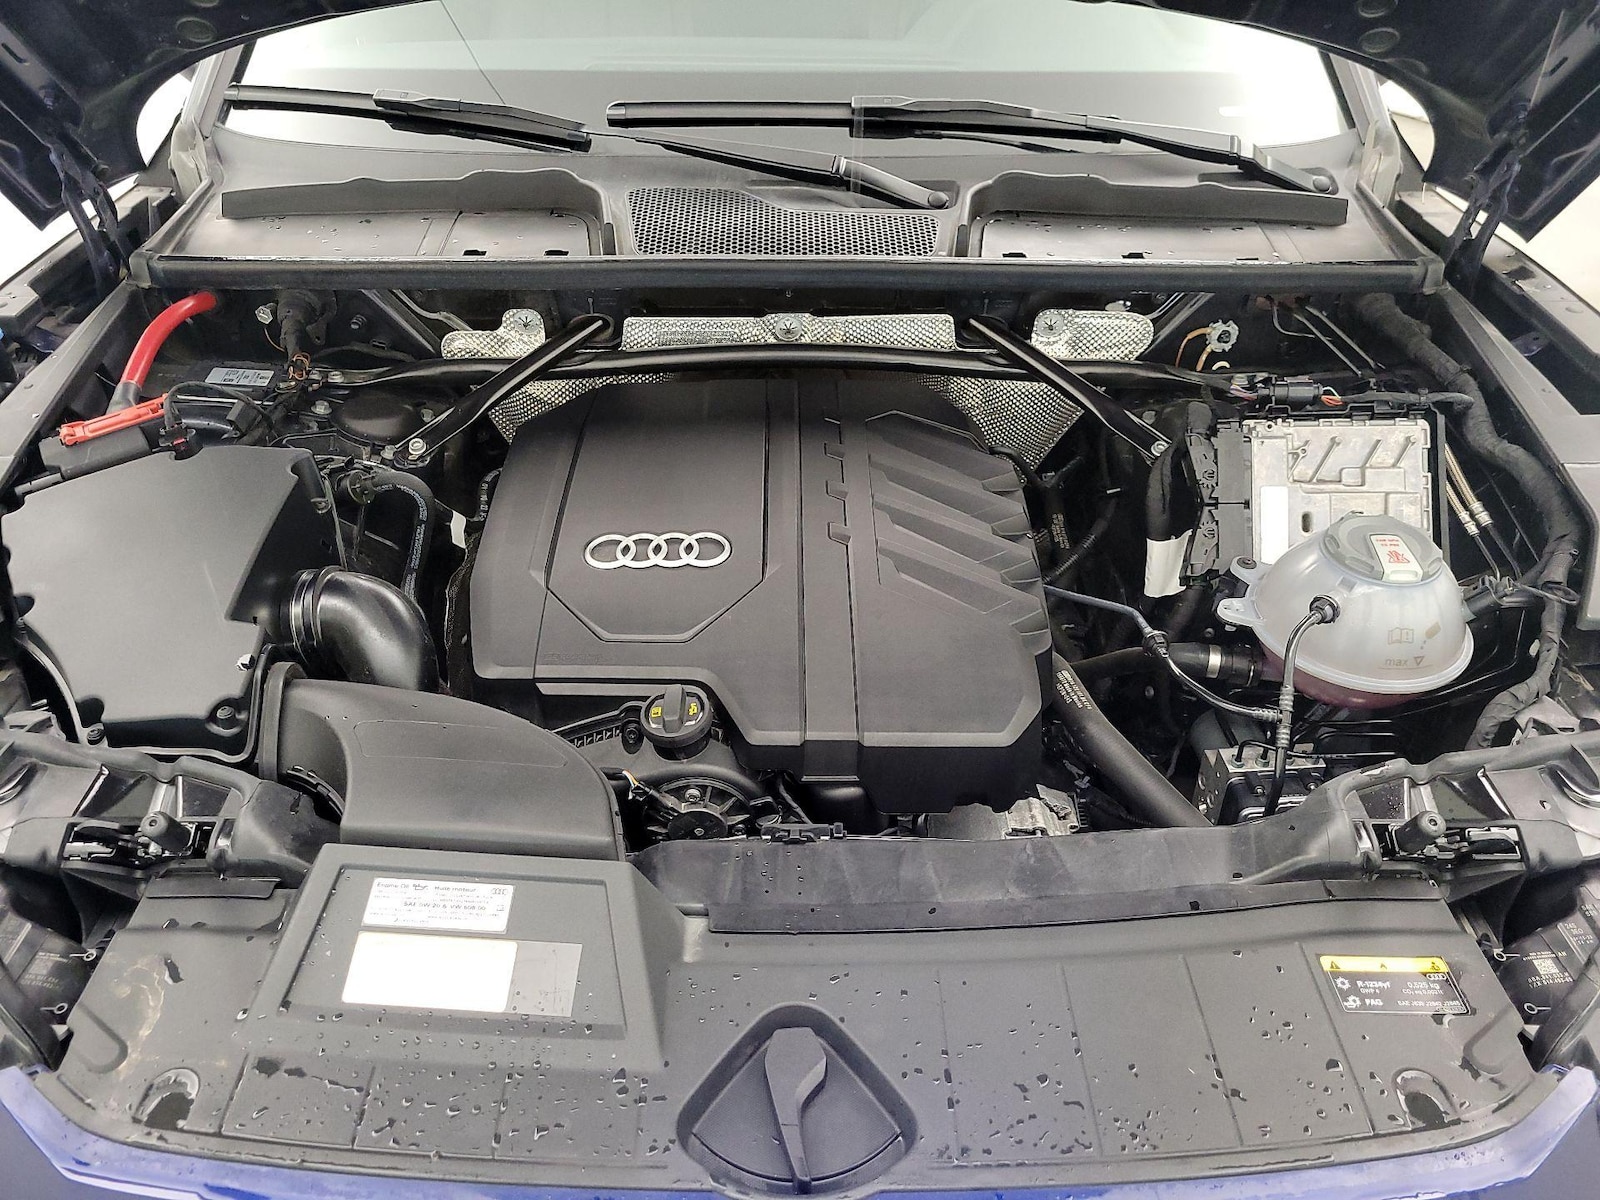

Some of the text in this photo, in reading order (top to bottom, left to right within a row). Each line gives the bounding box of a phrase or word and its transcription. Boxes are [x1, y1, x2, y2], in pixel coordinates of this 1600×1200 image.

[1384, 657, 1408, 667] max
[1356, 980, 1391, 990] R-1234yf
[1429, 981, 1441, 990] kg
[1364, 998, 1384, 1006] PAG
